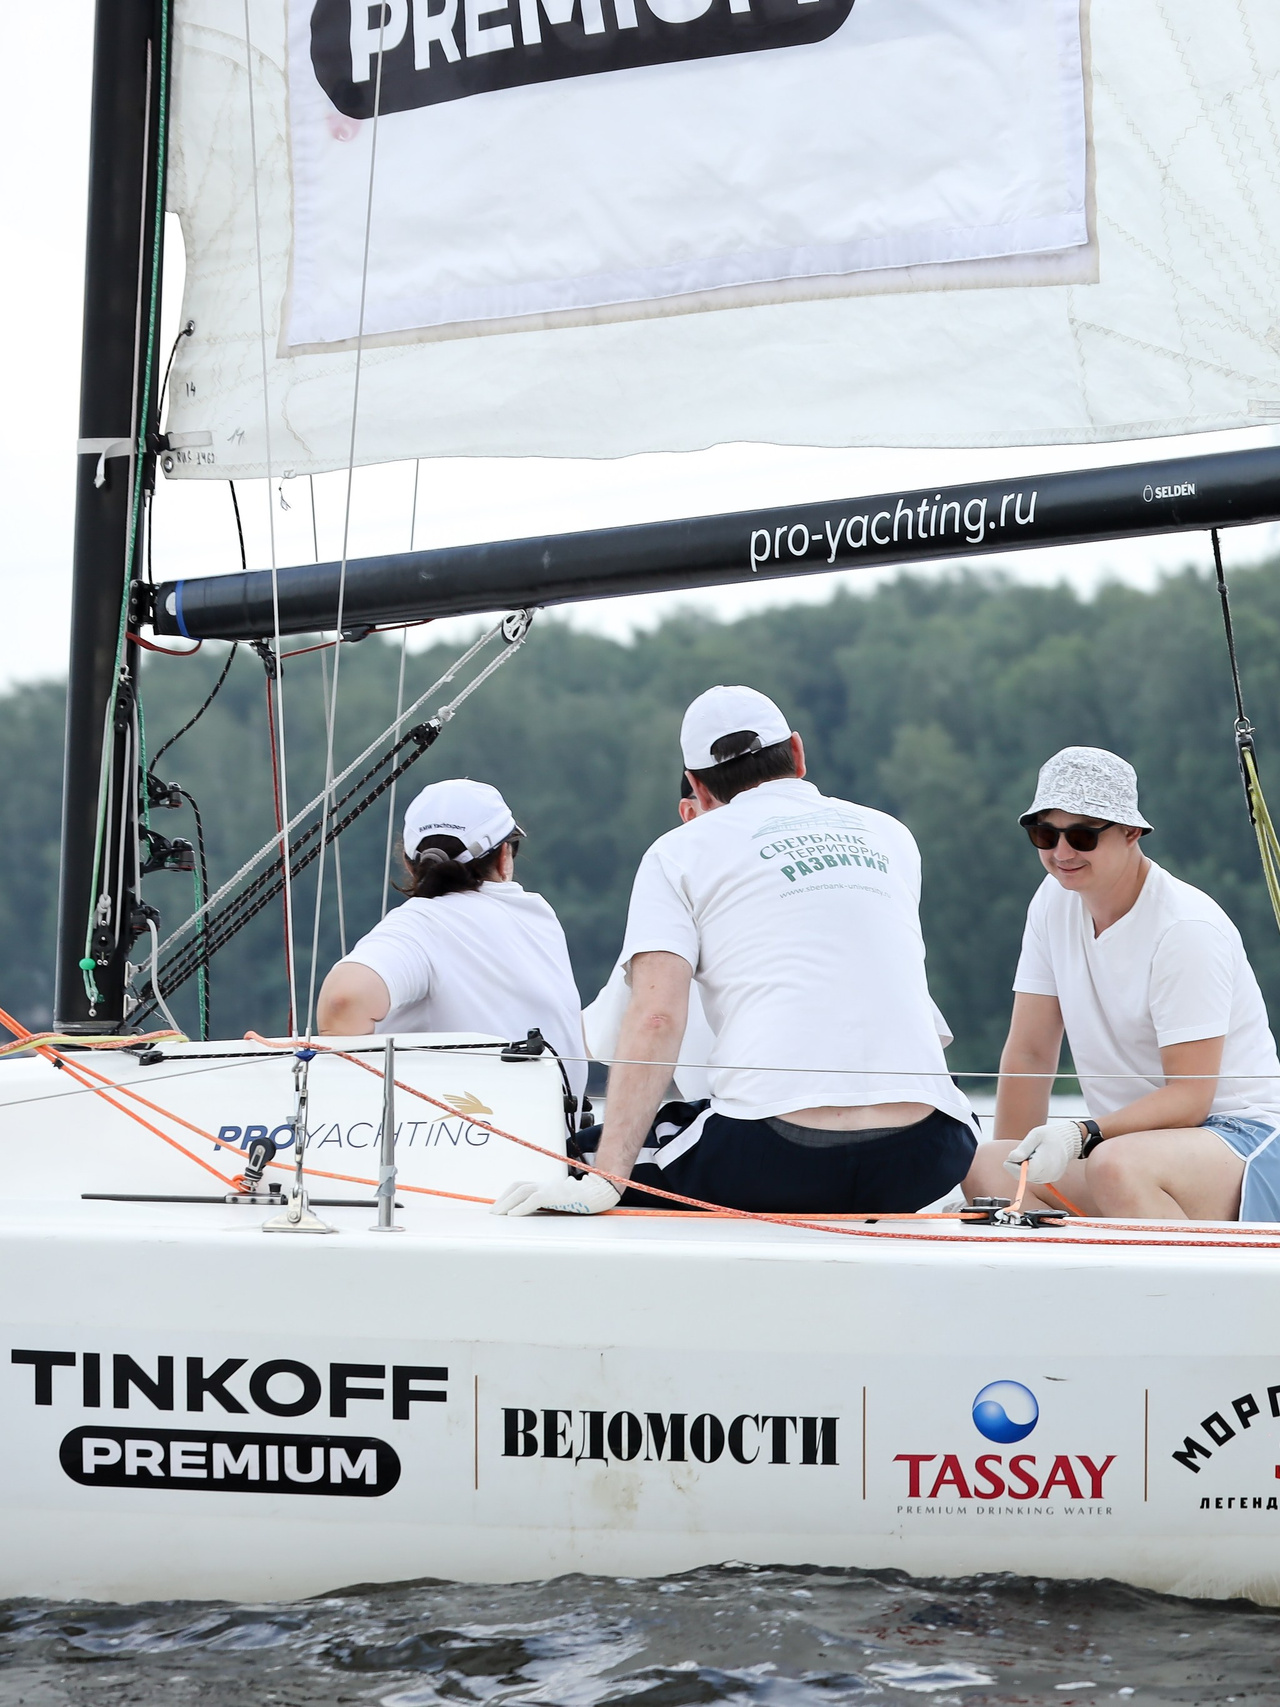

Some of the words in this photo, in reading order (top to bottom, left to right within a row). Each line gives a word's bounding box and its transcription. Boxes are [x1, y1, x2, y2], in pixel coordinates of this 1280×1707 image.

[185, 381, 196, 397] 14
[1154, 480, 1196, 499] SELDÉN
[749, 490, 1037, 572] pro-yachting.ru
[759, 833, 866, 860] СБЕРБАНК
[784, 844, 890, 865] ТЕРРИТОРИЯ
[780, 854, 888, 883] РАЗВИТИЯ
[11, 1349, 449, 1420] TINKOFF
[501, 1407, 840, 1468] ВЕДОМОСТИ
[82, 1437, 378, 1485] PREMIUM
[892, 1453, 1118, 1500] TASSAY
[897, 1505, 967, 1515] PREMIUM
[976, 1506, 1055, 1516] DRINKING
[1064, 1506, 1114, 1516] WATER
